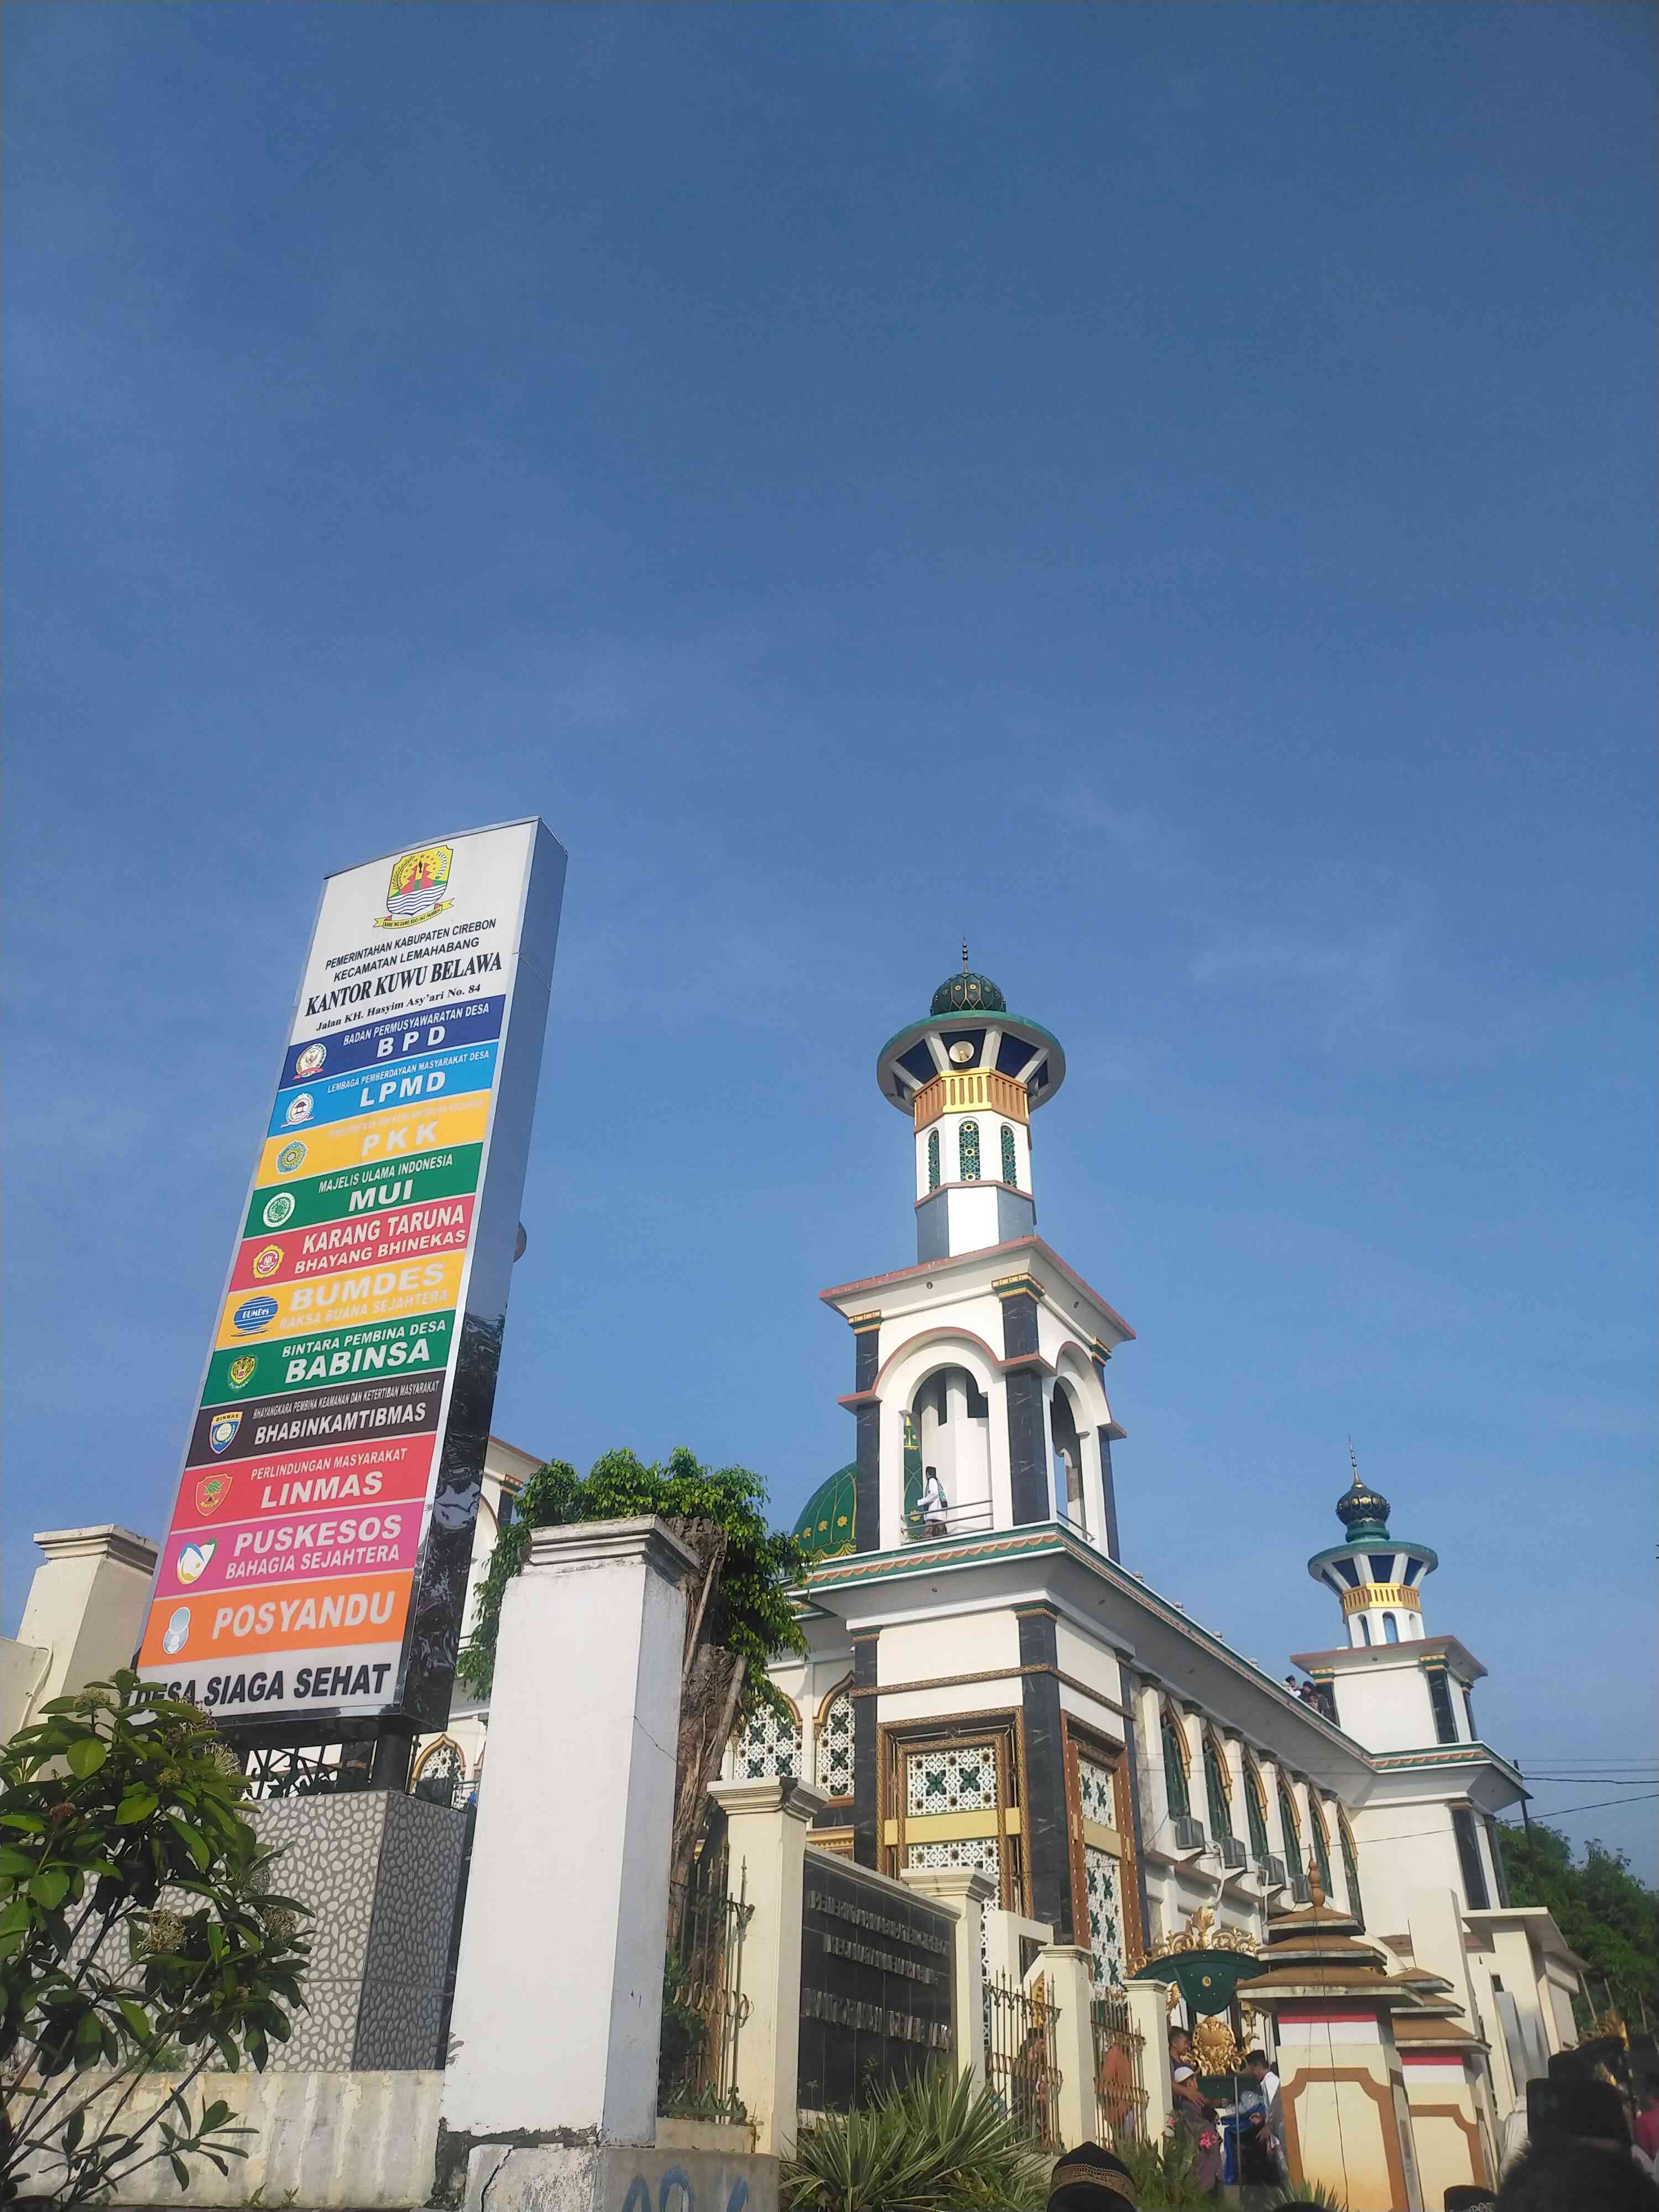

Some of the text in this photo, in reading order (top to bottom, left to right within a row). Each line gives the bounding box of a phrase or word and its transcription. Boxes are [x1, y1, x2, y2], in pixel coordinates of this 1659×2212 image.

[326, 918, 496, 970] PEMERINTAHAN KABUPATEN CIREBON
[333, 937, 479, 982] KECAMATAN LEMAHABANG
[305, 952, 502, 1017] KANTOR KUWU BELAWA
[316, 1019, 341, 1031] Jalan
[345, 1011, 364, 1024] KH.
[367, 1002, 404, 1019] Hasyim
[447, 987, 465, 999] No.
[468, 984, 481, 994] 84
[343, 1003, 489, 1046] BADAN PERMUSYAWARATAN DESA
[327, 1050, 489, 1093] LEMBAGA PEMBERDAYAAN MASYARAKAT DESA
[360, 1071, 446, 1108] LPMD
[319, 1154, 453, 1193] MAJELIS ULAMA INDONESIA
[348, 1179, 414, 1212] MUI
[302, 1204, 465, 1255] KARANG TARUNA
[294, 1229, 466, 1275] BHAYANG BHINEKAS
[290, 1262, 445, 1311] BUMDES
[325, 1303, 368, 1323] BUANA
[373, 1288, 448, 1314] SEJAHTERA
[281, 1319, 446, 1358] BINTARA PEMBINA DESA
[285, 1338, 430, 1384] BABINSA
[252, 1380, 440, 1420] BHAYANGKARA PEMBINA KEAMANAN DAN KETERTIBAN MASYARAKAT
[254, 1402, 426, 1446] BHABINKAMTIBMAS
[251, 1448, 408, 1481] PERLINDUNGAN MASYARAKAT
[260, 1470, 383, 1509] LINMAS
[233, 1514, 402, 1557] PUSKESOS
[225, 1544, 399, 1580] BAHAGIA SEJAHTERA
[212, 1590, 395, 1640] POSYANDU
[204, 1671, 283, 1707] SIAGA
[294, 1663, 391, 1698] SEHAT
